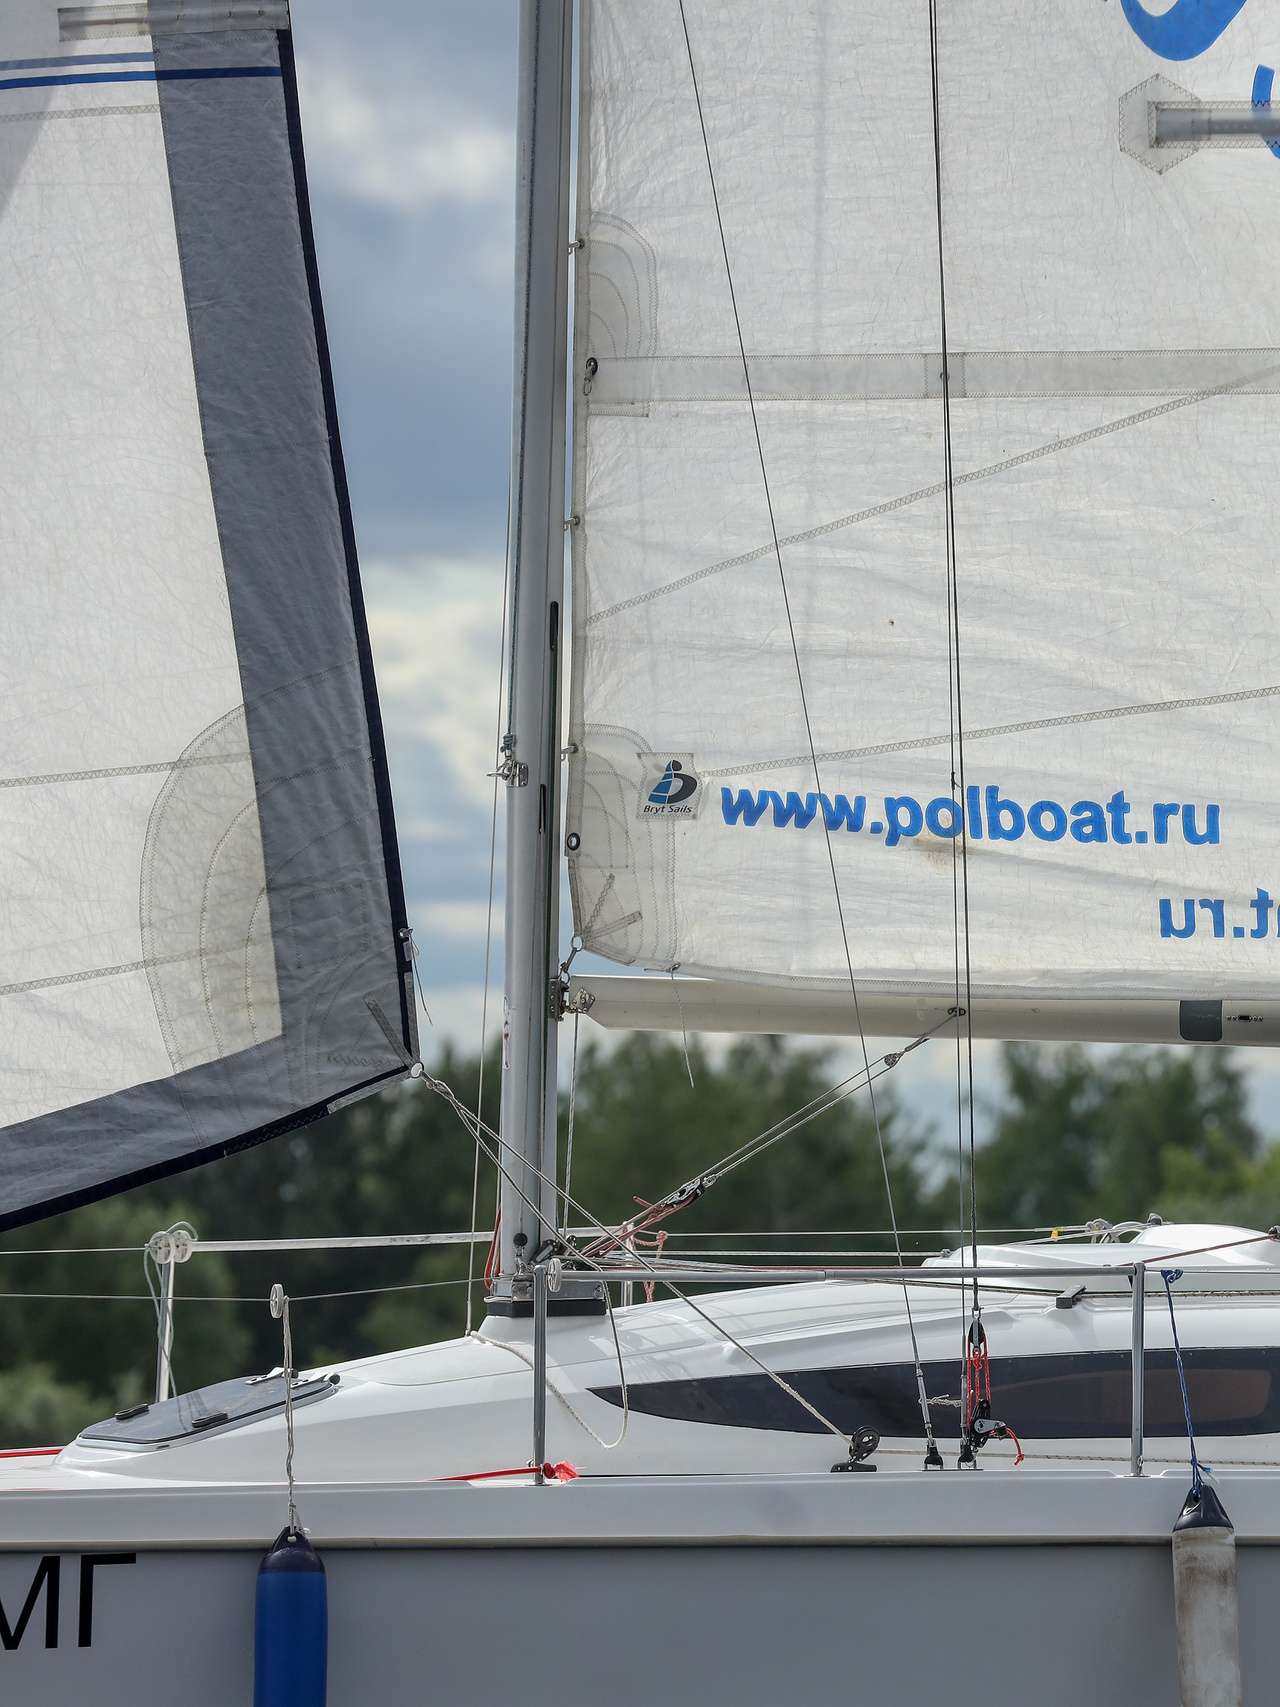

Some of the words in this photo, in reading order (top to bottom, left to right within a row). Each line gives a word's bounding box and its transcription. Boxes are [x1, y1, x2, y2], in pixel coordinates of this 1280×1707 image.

[643, 805, 666, 814] Bryt
[668, 805, 693, 813] Sails
[720, 785, 1220, 846] www.polboat.ru
